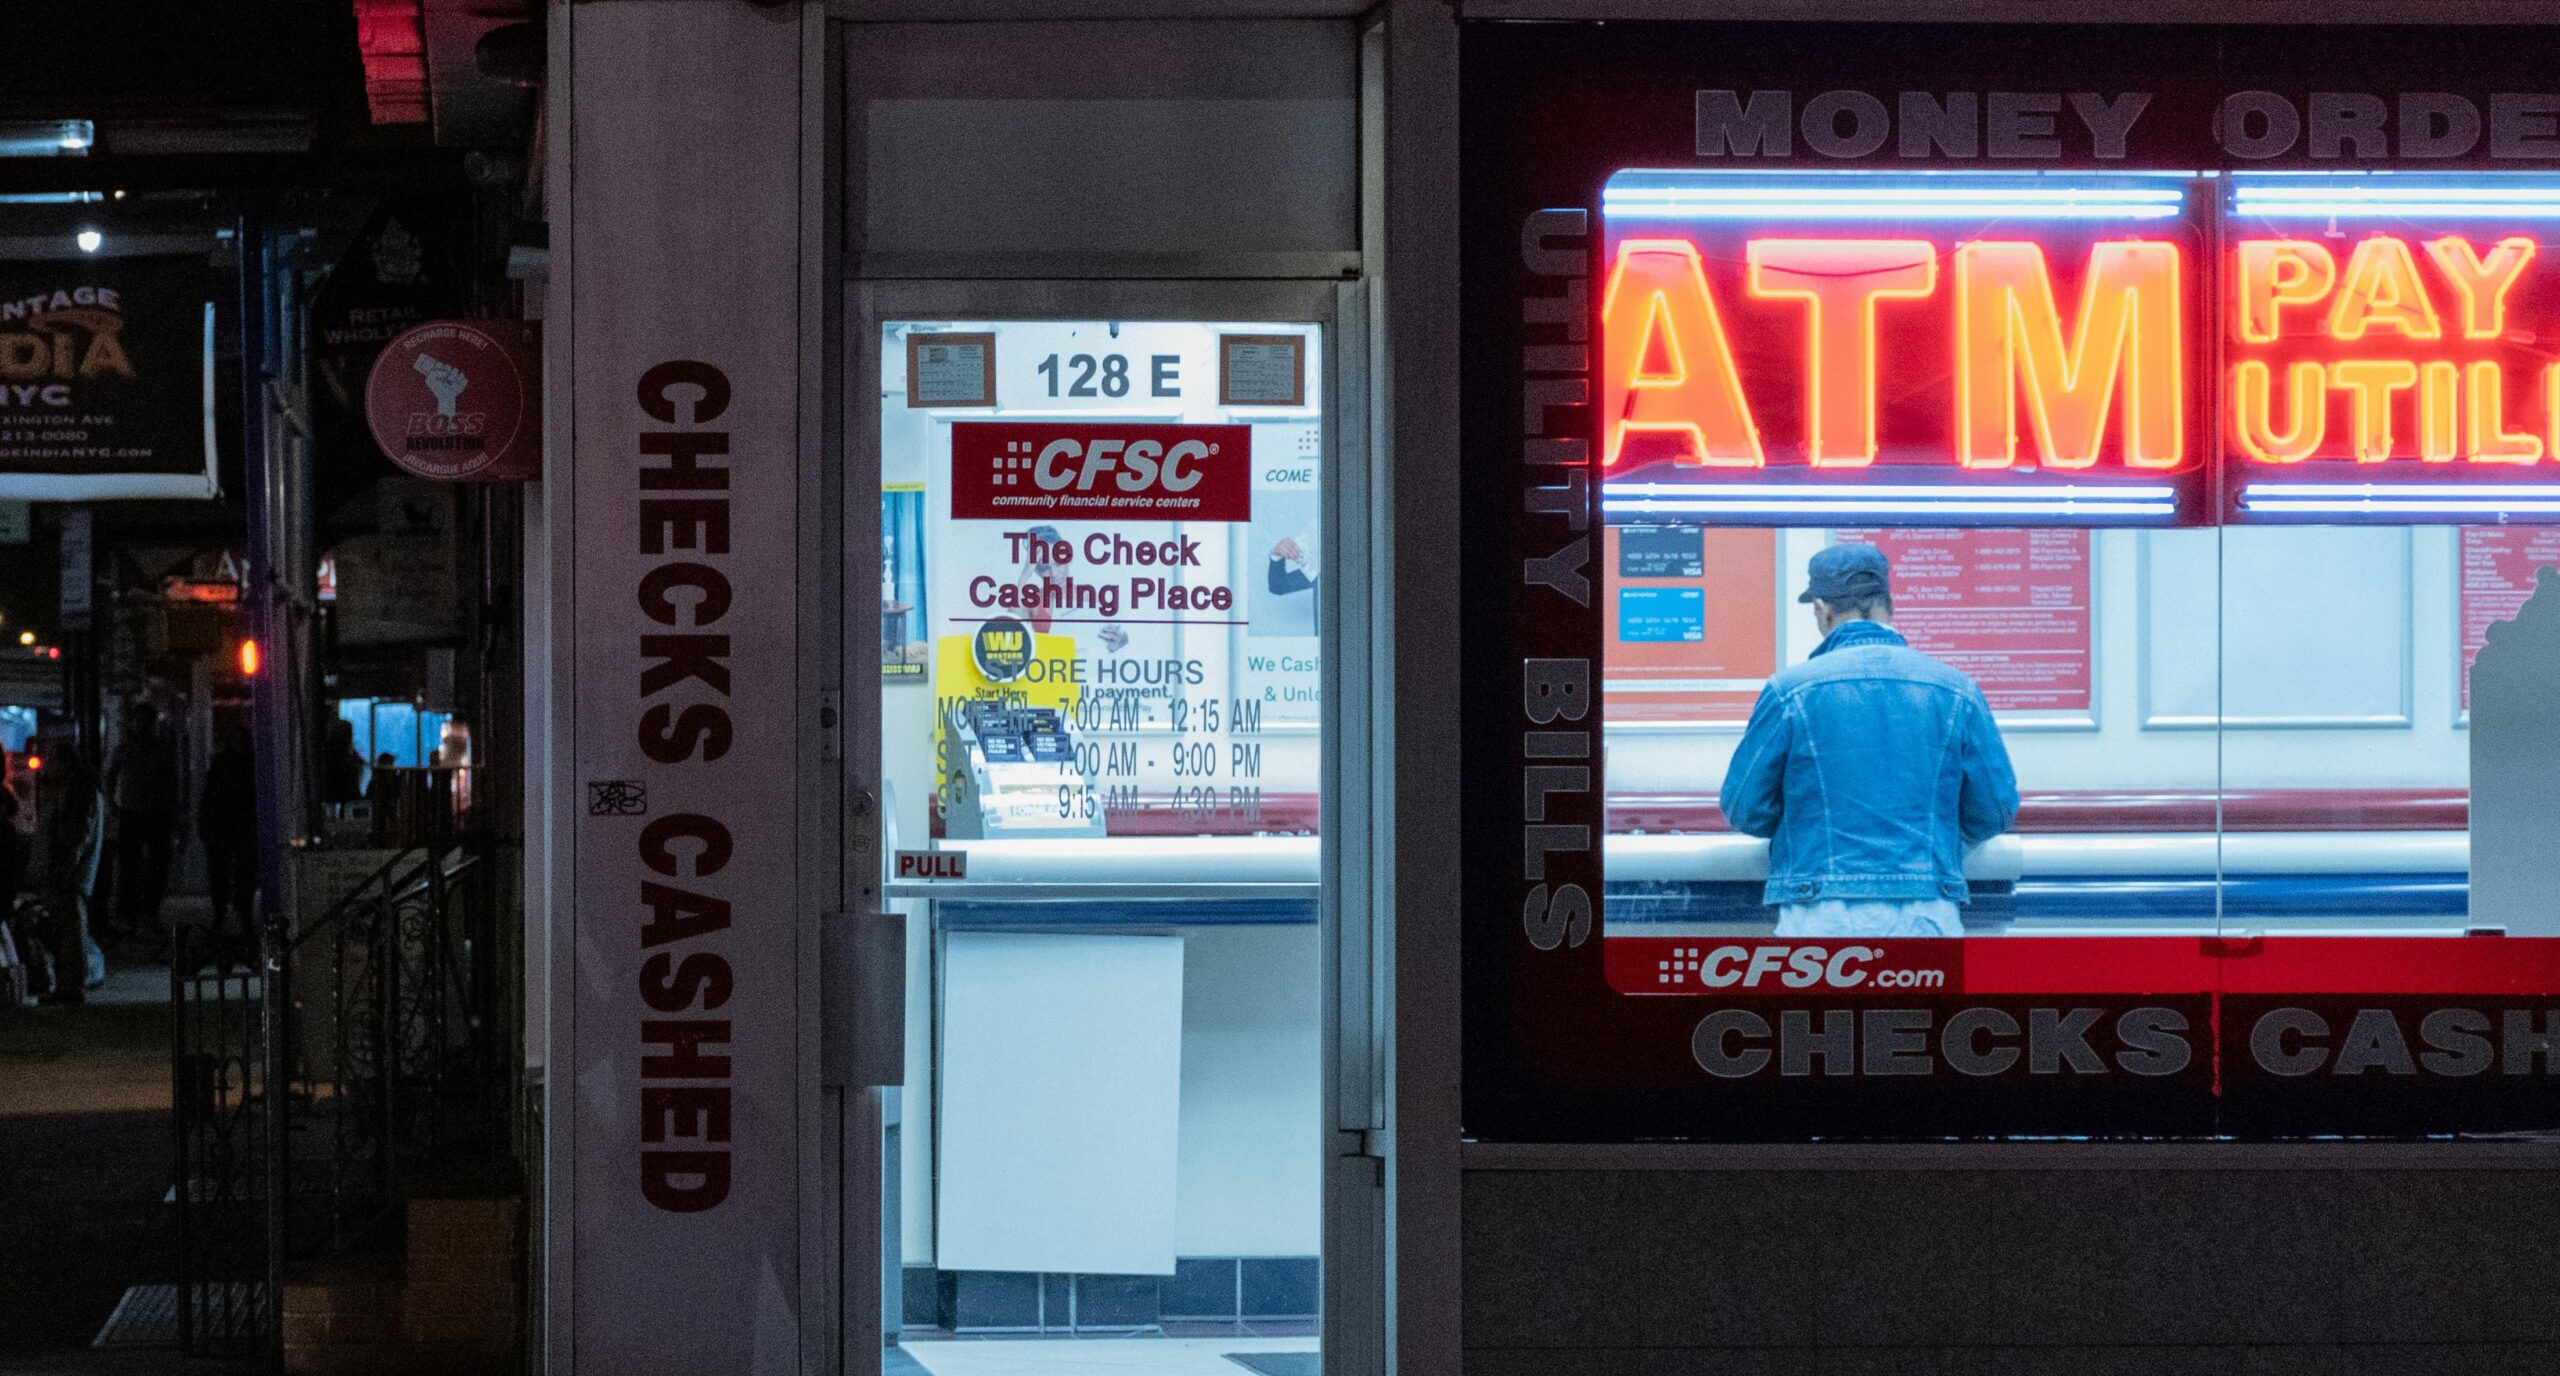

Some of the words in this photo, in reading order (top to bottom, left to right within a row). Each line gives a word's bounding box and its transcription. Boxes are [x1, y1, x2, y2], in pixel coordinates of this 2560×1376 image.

[1695, 89, 2152, 159] MONEY
[2214, 90, 2560, 159] ORDE
[2239, 237, 2537, 343] PAY
[404, 328, 457, 350] RECHARGE
[458, 330, 488, 350] HERE!
[1603, 238, 2184, 469] ATM
[1037, 353, 1130, 398] 128
[1151, 354, 1181, 397] E
[407, 412, 486, 435] BOSS
[1521, 208, 1590, 608] UTILITY
[406, 436, 486, 450] REVOLUTION
[1265, 468, 1312, 483] COME
[991, 494, 1057, 509] community
[1059, 493, 1109, 507] financial
[1110, 496, 1153, 507] service
[1156, 496, 1200, 508] centers
[637, 360, 734, 764] CHECKS
[1003, 532, 1073, 566] The
[1084, 533, 1201, 567] Check
[969, 576, 1120, 616] Cashing
[1131, 577, 1233, 611] Place
[982, 631, 1024, 651] WU
[984, 658, 1088, 684] STORE
[1097, 658, 1204, 684] HOURS
[1248, 656, 1276, 672] We
[975, 687, 999, 699] Start
[1003, 687, 1028, 699] Here
[1095, 684, 1173, 702] payment.
[1264, 686, 1277, 702] &
[1058, 697, 1101, 732] 7:00
[1109, 698, 1139, 731] AM
[1167, 698, 1220, 733] 12:15
[1231, 699, 1261, 733] AM
[1106, 742, 1138, 777] AM
[1172, 742, 1216, 777] 9:00
[1232, 743, 1261, 777] PM
[1058, 784, 1096, 819] 9:15
[1108, 785, 1138, 819] AM
[1171, 785, 1216, 822] 4:30
[1230, 786, 1261, 822] PM
[1523, 658, 1592, 951] BILLS
[900, 855, 964, 878] PULL
[638, 813, 734, 1213] CASHED
[1691, 1007, 2192, 1077] CHECKS
[2249, 1008, 2560, 1078] CASH
